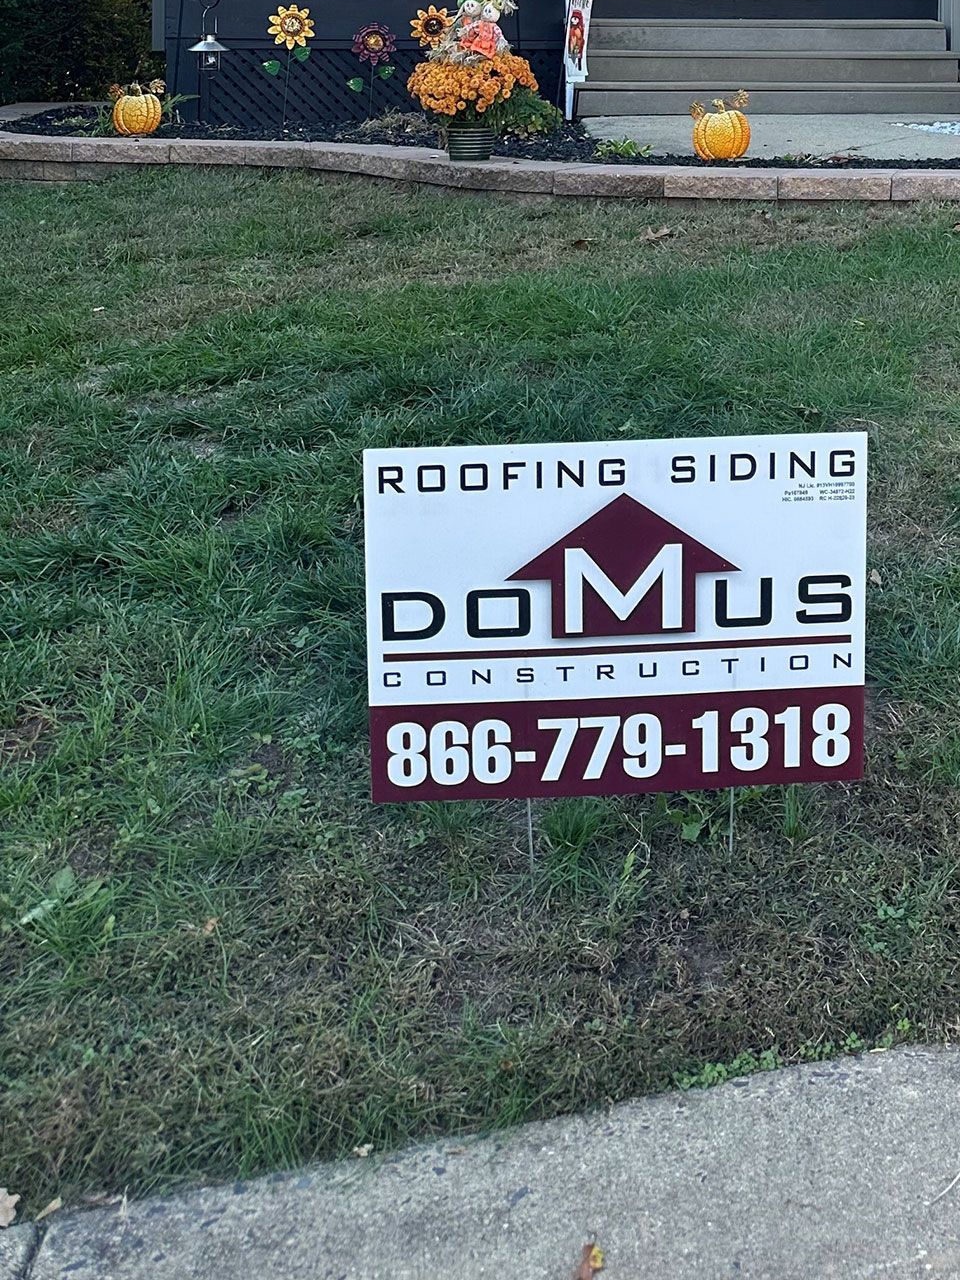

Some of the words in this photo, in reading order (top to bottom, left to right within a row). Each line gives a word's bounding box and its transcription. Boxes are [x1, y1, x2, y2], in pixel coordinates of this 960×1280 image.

[377, 458, 626, 495] ROOFING
[671, 449, 856, 484] SIDING
[380, 543, 853, 642] DOMUS
[382, 652, 853, 688] CONSTRUCTION
[386, 703, 852, 788] 866-779-1318
